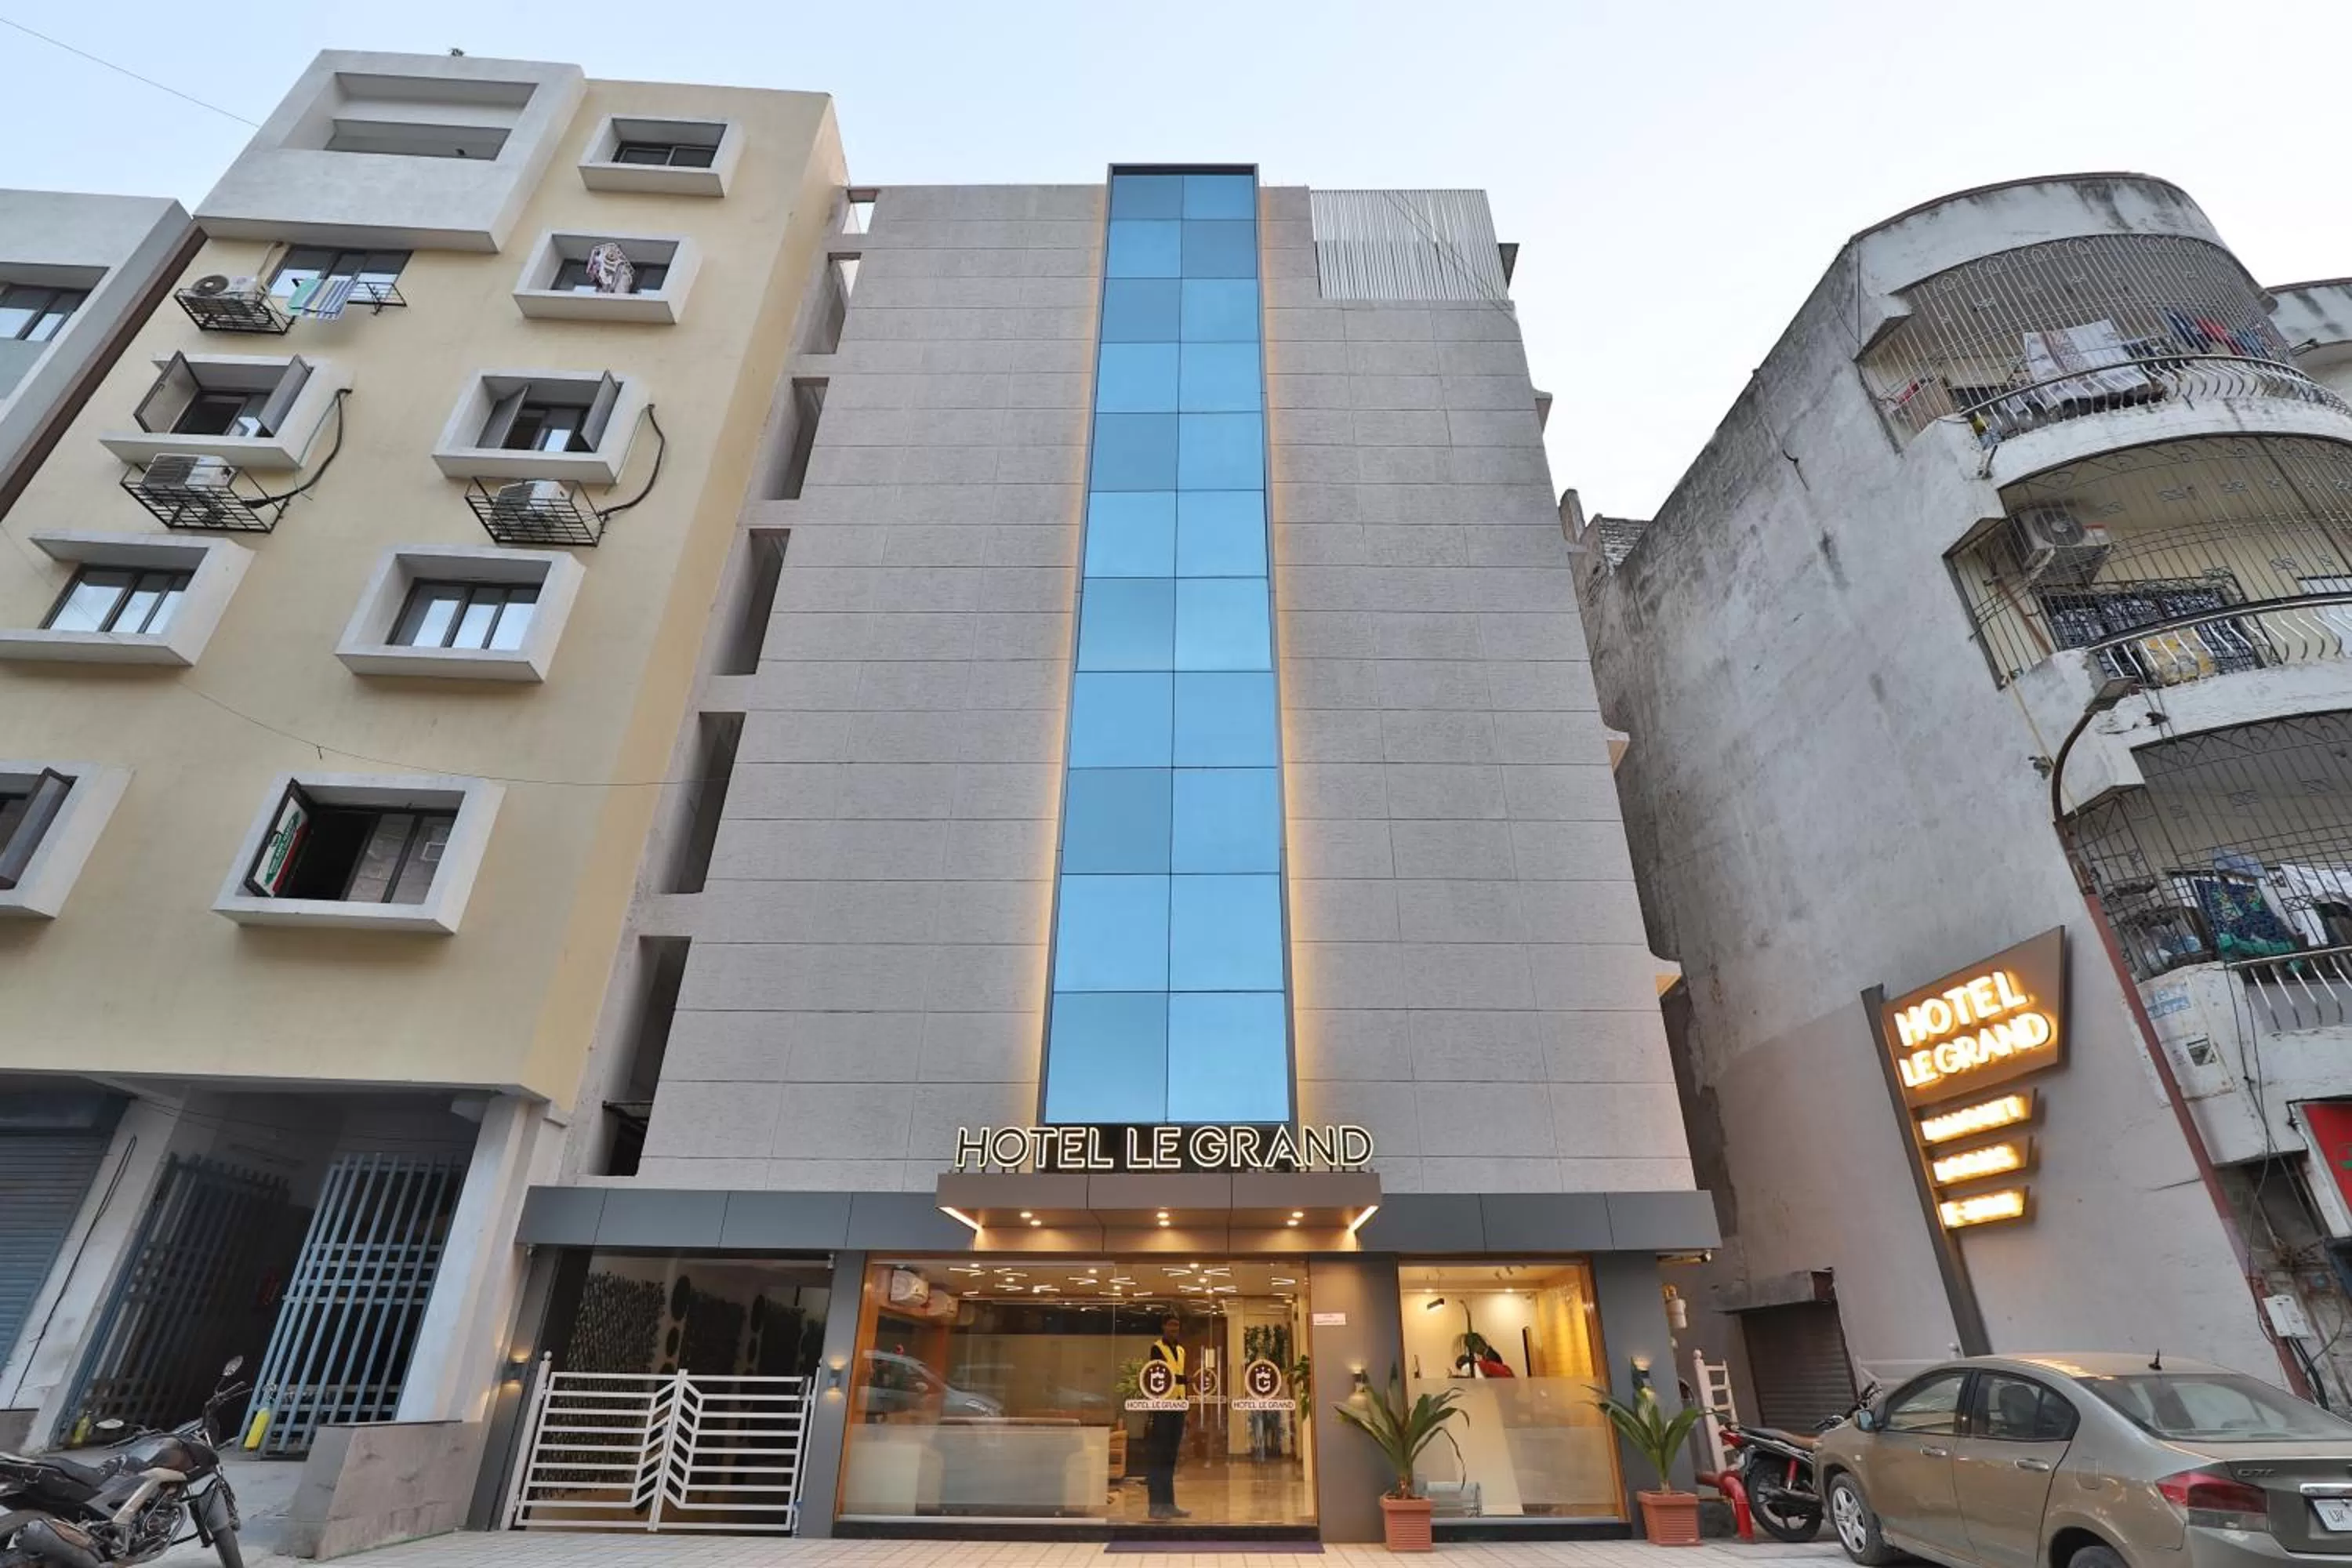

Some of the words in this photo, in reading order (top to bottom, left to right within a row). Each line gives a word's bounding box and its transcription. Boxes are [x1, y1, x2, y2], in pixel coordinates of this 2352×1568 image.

[1894, 971, 2029, 1047] HOTEL
[1898, 1049, 1939, 1088] LE
[1934, 1012, 2051, 1073] GRAND
[954, 1127, 1113, 1169] HOTEL
[1126, 1127, 1181, 1169] LE
[1189, 1123, 1374, 1167] GRAND
